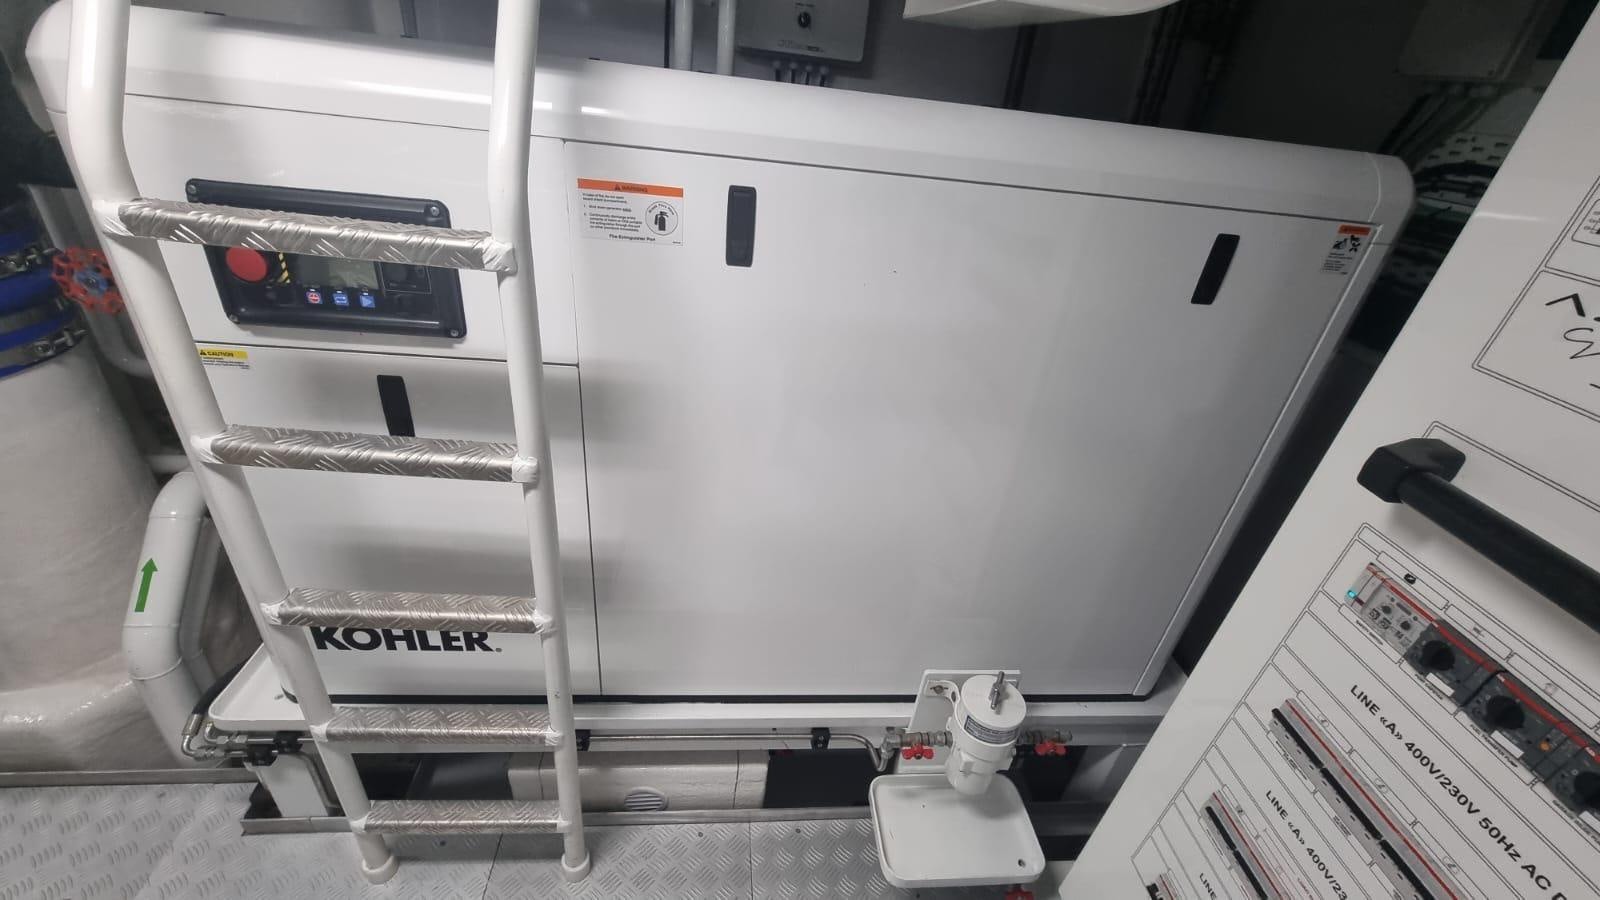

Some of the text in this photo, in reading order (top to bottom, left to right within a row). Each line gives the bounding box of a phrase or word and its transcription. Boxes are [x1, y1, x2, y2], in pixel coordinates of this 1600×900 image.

[1265, 790, 1289, 820] LINE
[1287, 821, 1305, 845] «A»
[1350, 684, 1381, 716] LINE
[1380, 715, 1403, 741] «A»
[1404, 741, 1481, 816] 400V/230V
[1478, 816, 1522, 862] 50Hz
[1521, 863, 1553, 891] AC
